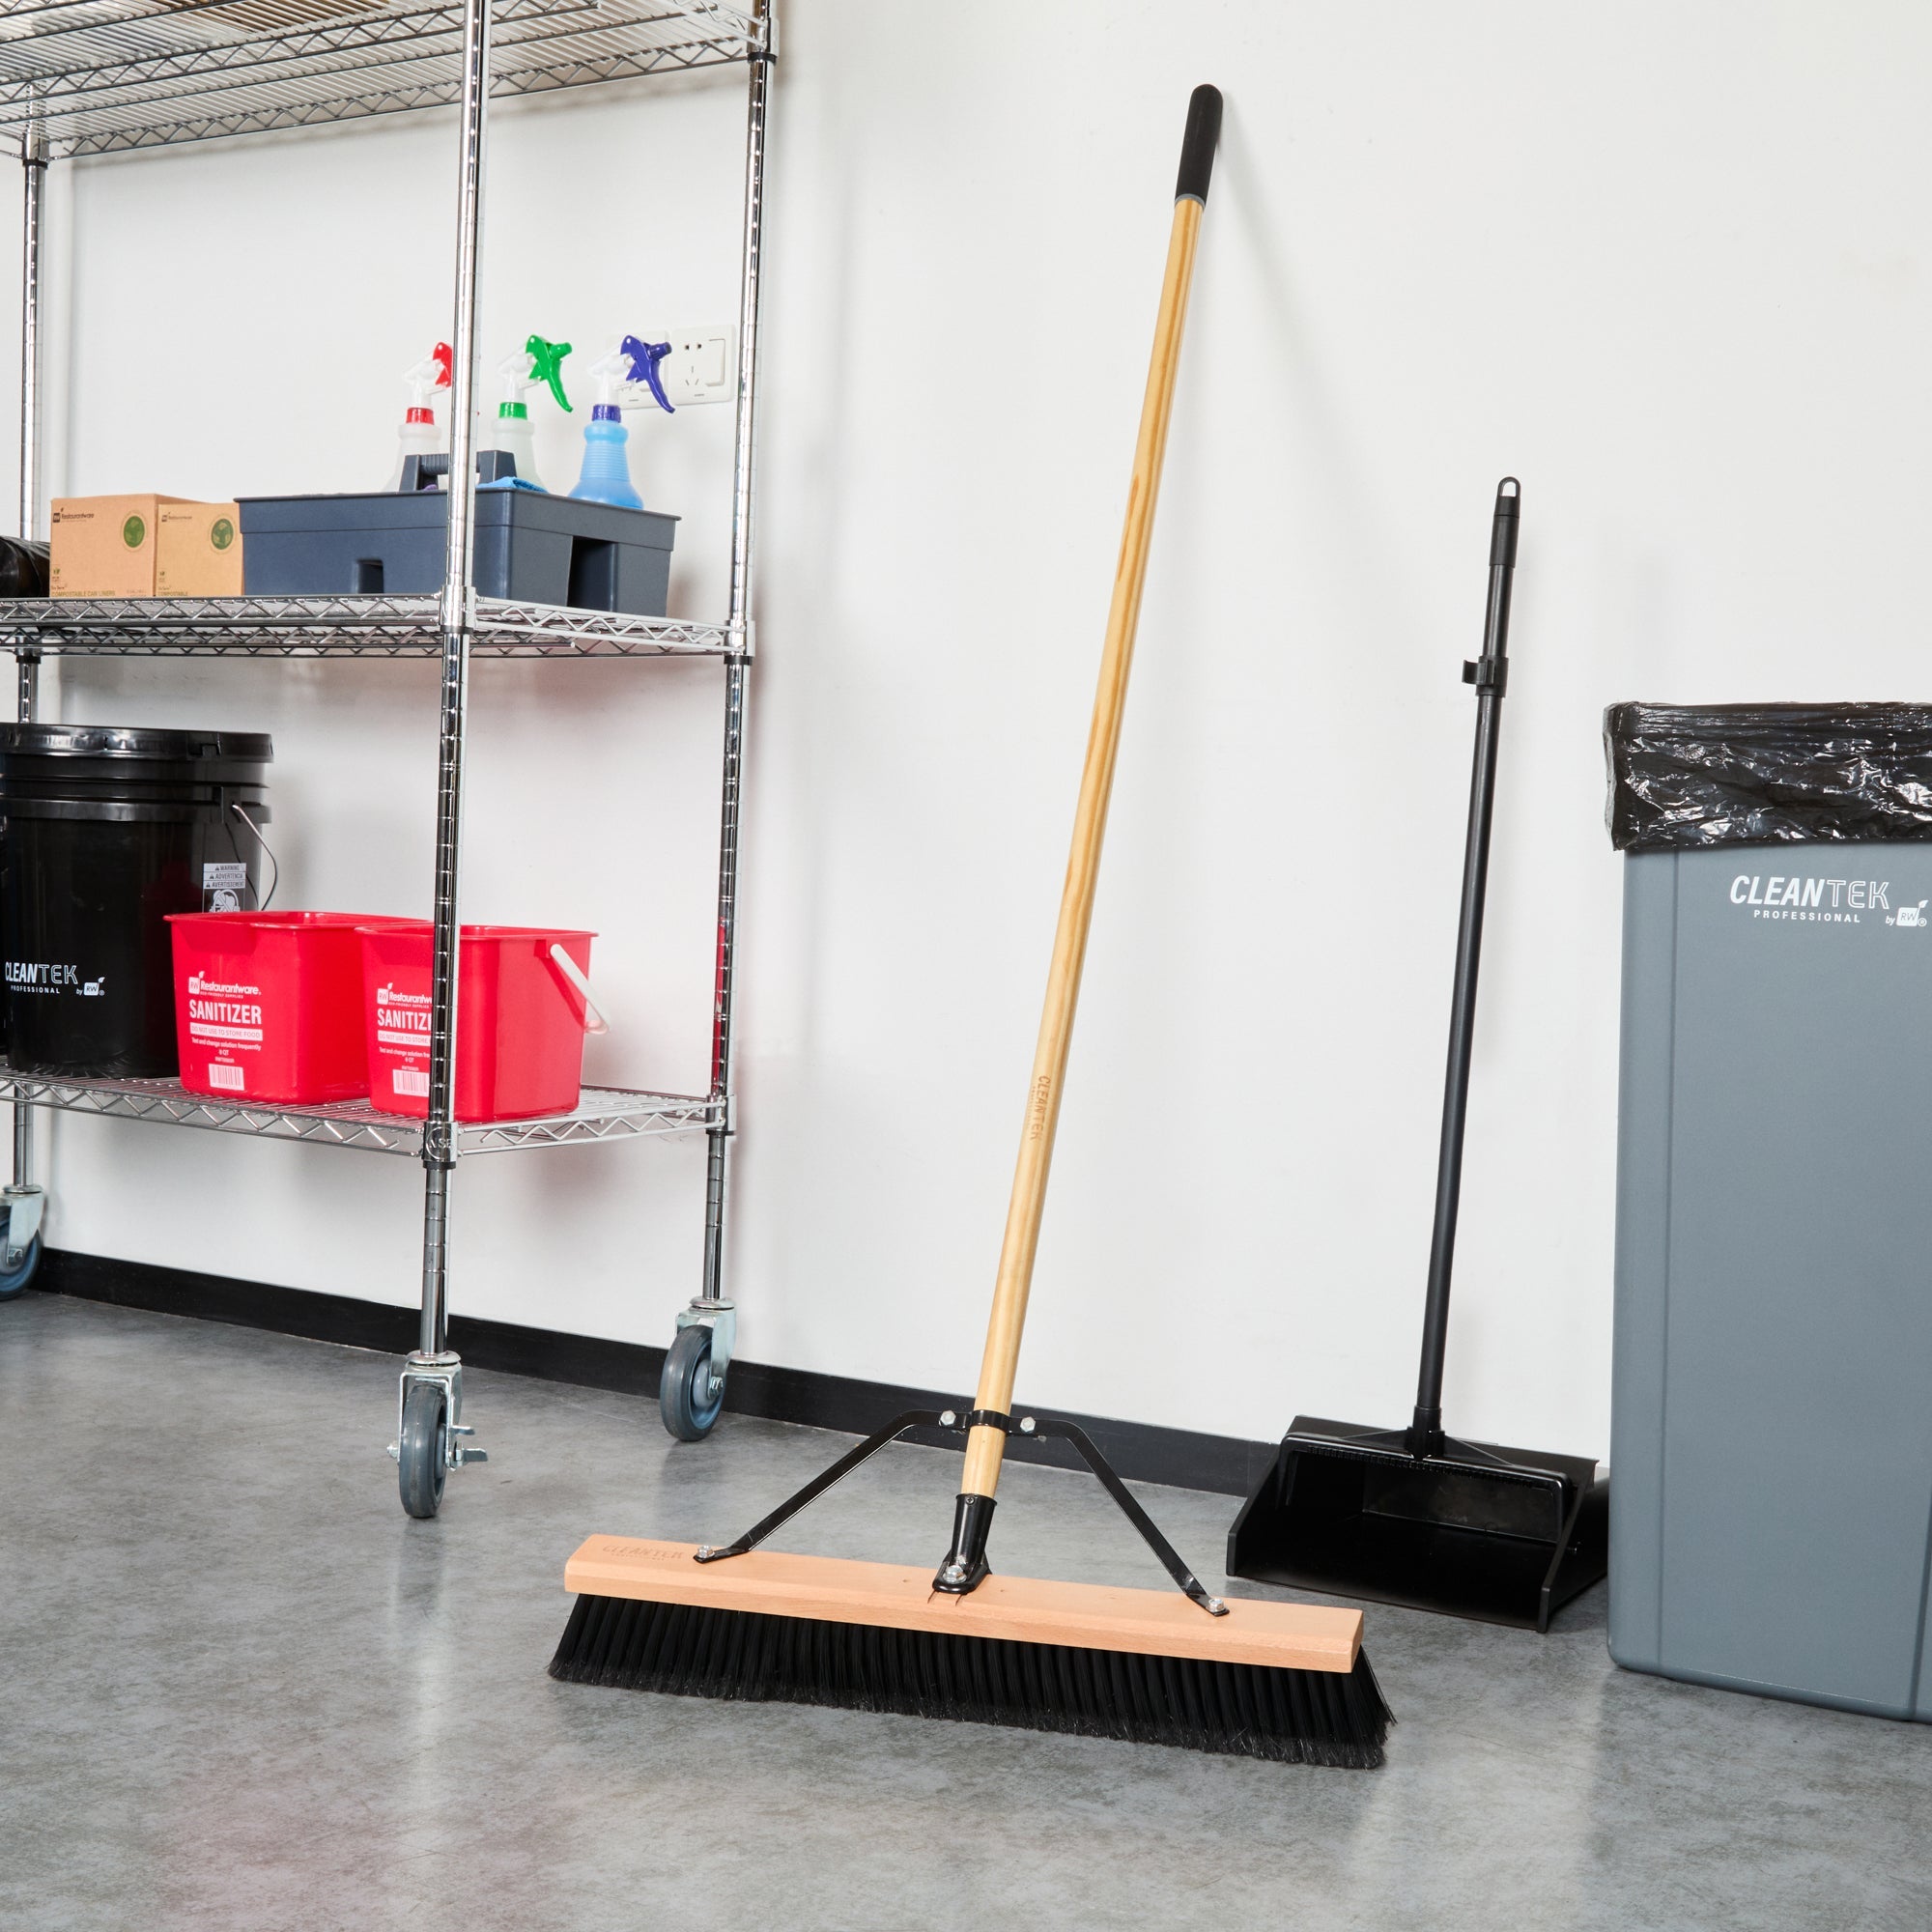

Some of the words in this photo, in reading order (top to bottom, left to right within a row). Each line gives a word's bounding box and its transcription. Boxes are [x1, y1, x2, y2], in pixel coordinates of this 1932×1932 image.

[1729, 874, 1890, 910] CLEANTEK
[1753, 909, 1861, 923] PROFESSIONAL
[1885, 915, 1896, 926] by
[5, 961, 78, 984] CLEANTEK
[11, 984, 60, 994] PROFESSIONAL
[200, 980, 260, 995] Restaurantware
[388, 991, 433, 1004] Restaurantw
[189, 999, 262, 1025] SANITIZER
[1030, 1075, 1051, 1141] CLEANTEK
